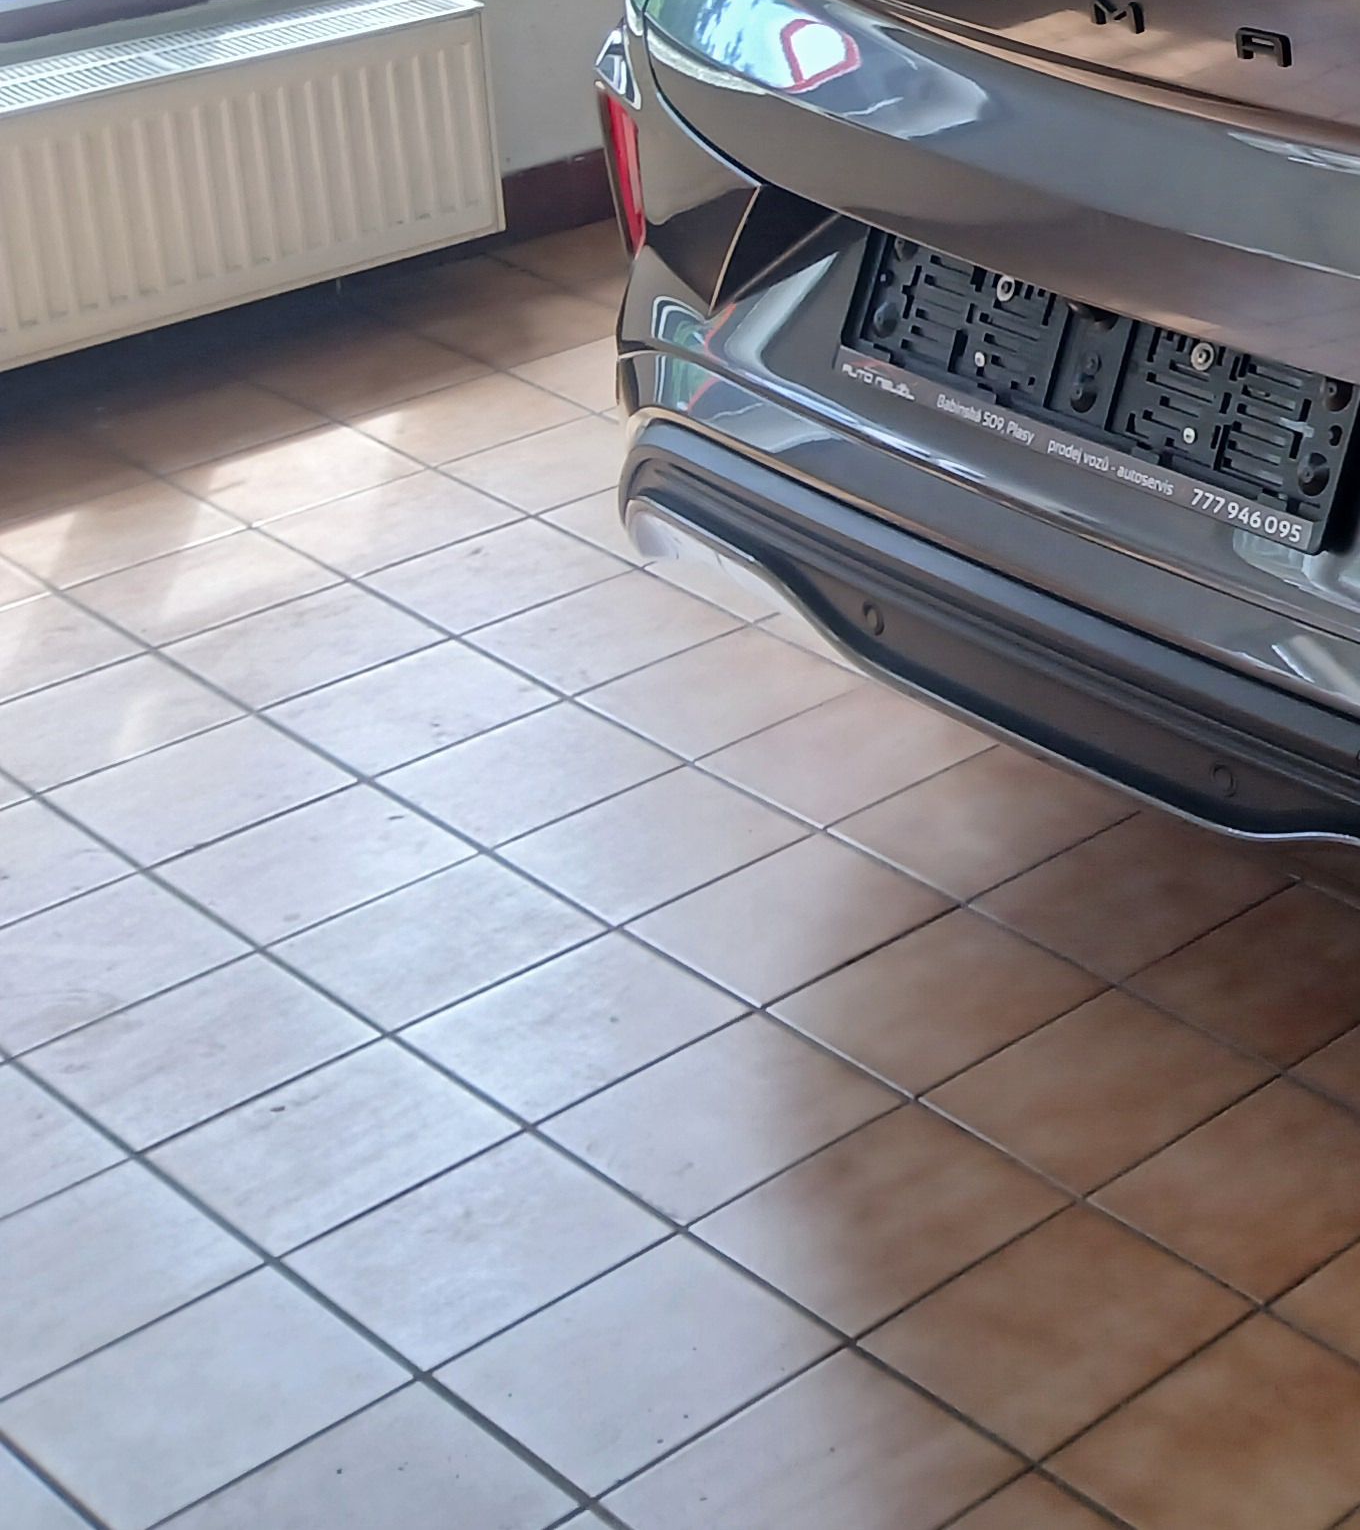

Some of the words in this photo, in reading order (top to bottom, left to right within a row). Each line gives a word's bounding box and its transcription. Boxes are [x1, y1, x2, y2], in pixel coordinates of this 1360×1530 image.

[1006, 420, 1035, 446] Plasy
[1047, 439, 1083, 464] prodej
[1116, 465, 1175, 496] autoservis
[1190, 488, 1226, 514] 777
[1227, 501, 1262, 529] 946
[1264, 516, 1303, 543] 095
